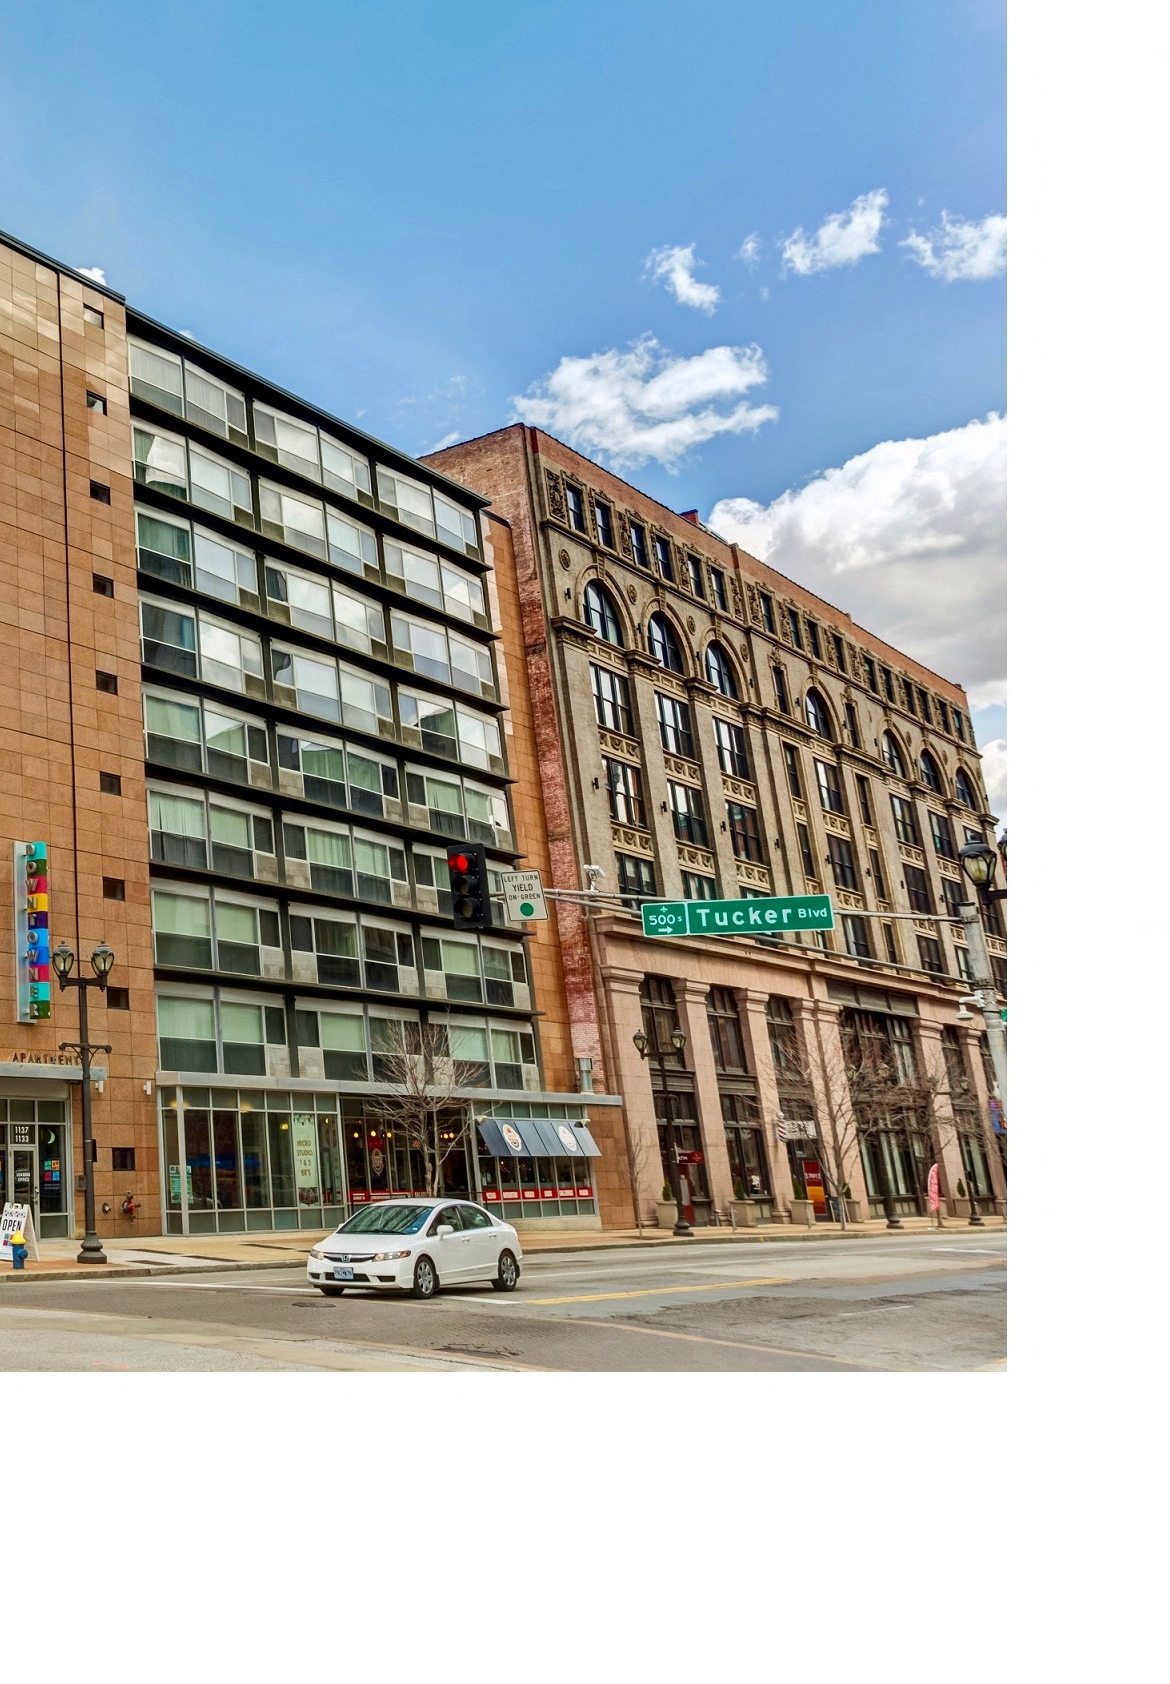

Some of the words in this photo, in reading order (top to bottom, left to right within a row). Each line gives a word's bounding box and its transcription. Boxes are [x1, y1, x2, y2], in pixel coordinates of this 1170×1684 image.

[511, 883, 534, 892] YIELD
[649, 914, 676, 926] 500
[696, 906, 792, 927] Tucker
[797, 907, 828, 919] Blvd
[25, 844, 39, 1016] DOWNTOWNER
[14, 1126, 30, 1134] 1137
[14, 1135, 30, 1143] 1133
[1, 1218, 23, 1232] OPEN
